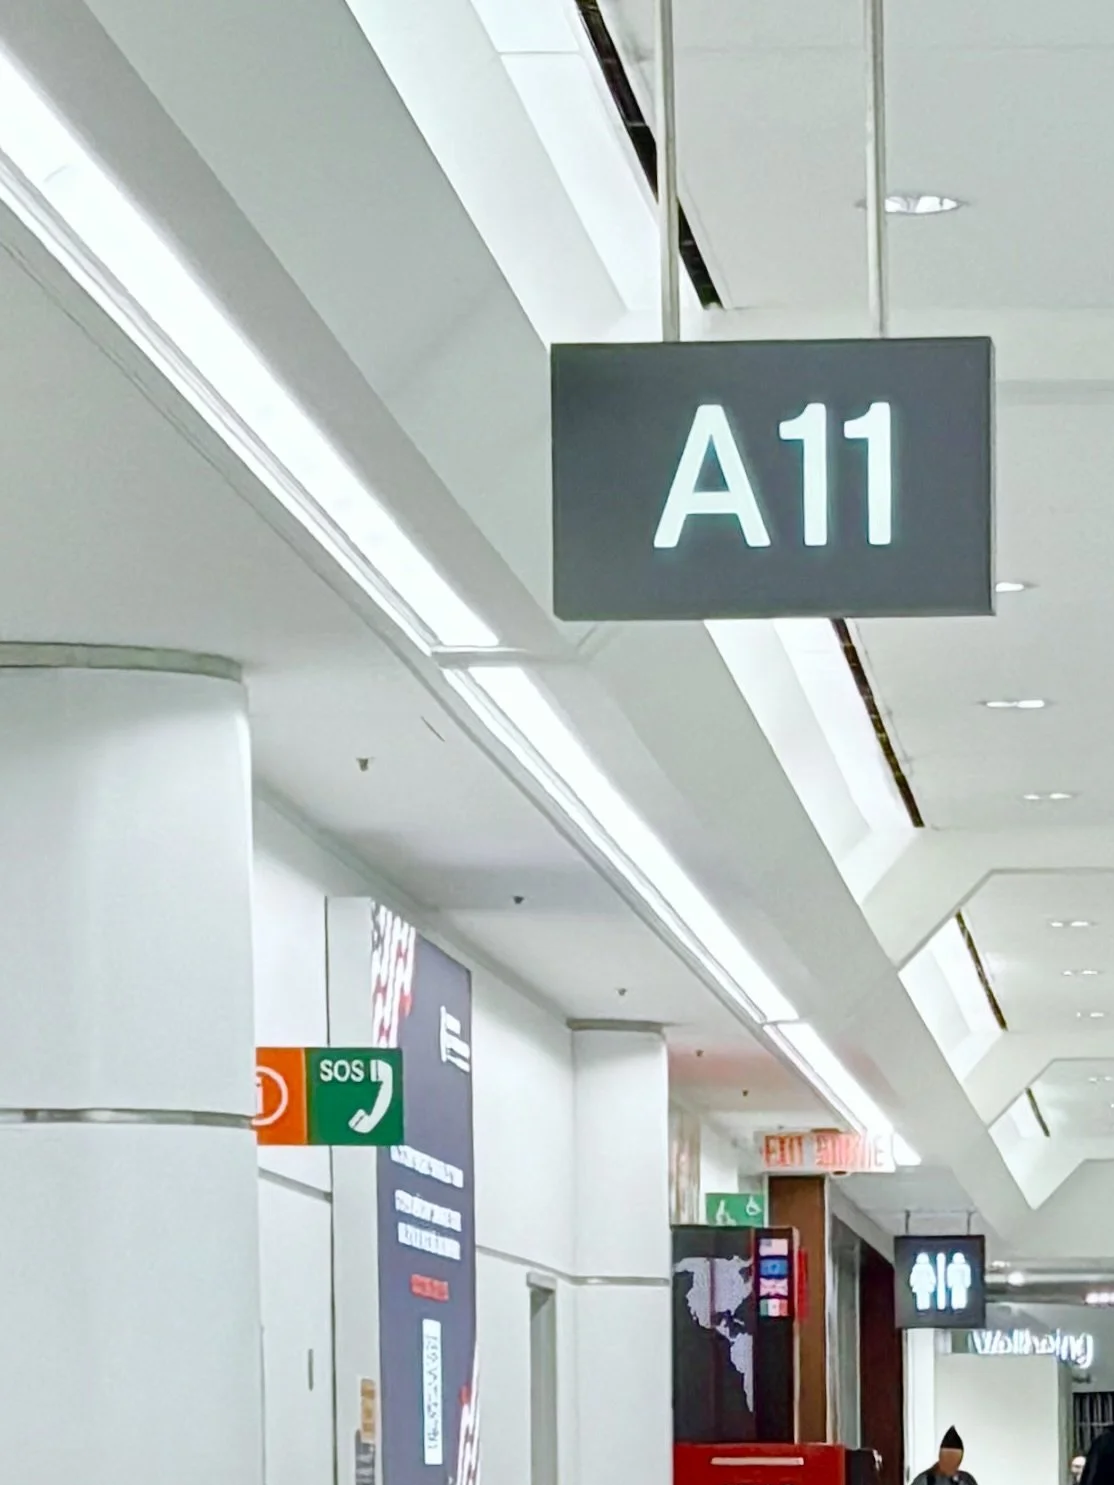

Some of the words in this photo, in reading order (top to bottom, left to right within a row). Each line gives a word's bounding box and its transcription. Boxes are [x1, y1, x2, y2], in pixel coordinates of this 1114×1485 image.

[653, 402, 892, 548] A11
[320, 1059, 365, 1082] SOS
[764, 1135, 804, 1167] EXIT
